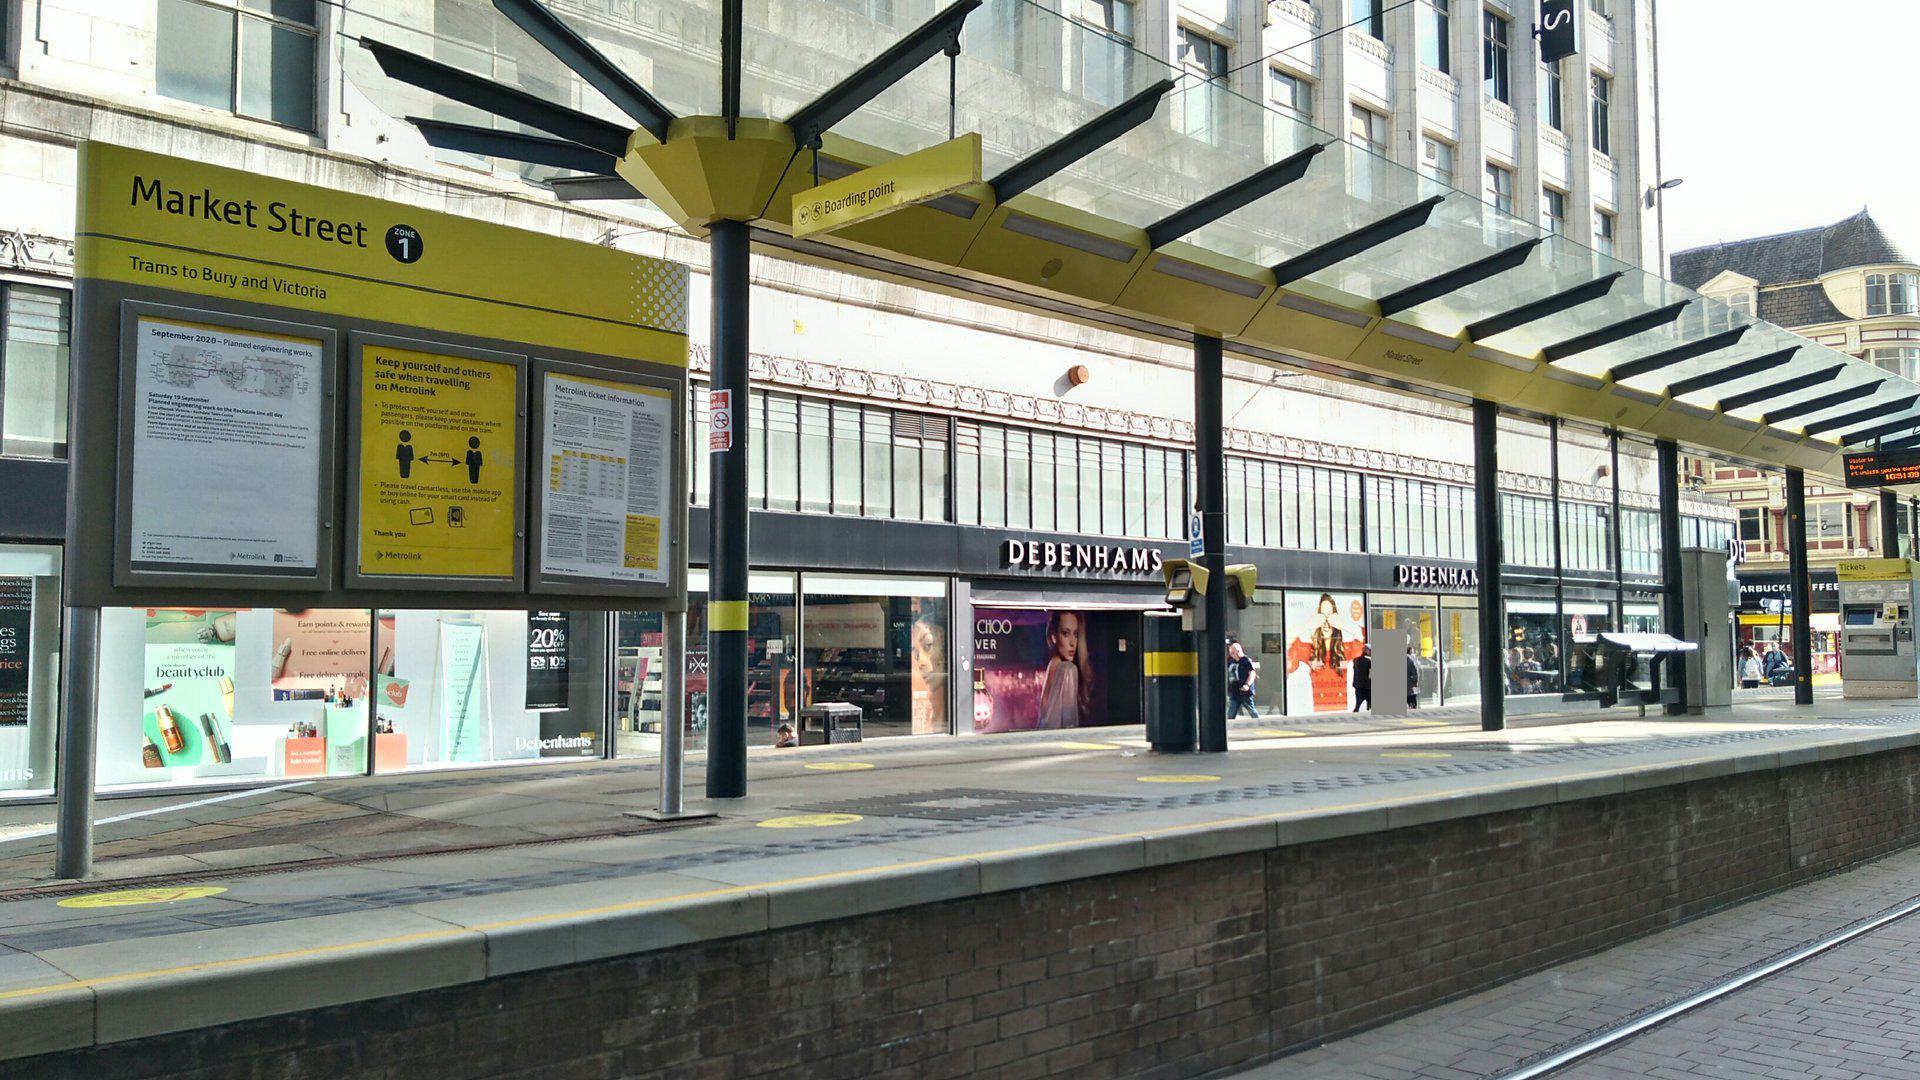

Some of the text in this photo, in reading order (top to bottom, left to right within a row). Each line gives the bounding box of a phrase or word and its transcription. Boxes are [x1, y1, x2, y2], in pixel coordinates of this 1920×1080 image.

[824, 180, 896, 215] Boarding point
[131, 176, 368, 248] Market Street
[394, 228, 416, 238] ZONE
[398, 238, 409, 260] 1
[129, 256, 327, 300] Trams to Bury and Victoria
[152, 328, 194, 343] September
[196, 336, 217, 344] 2020
[223, 338, 252, 350] Planned
[252, 342, 293, 356] engineering
[293, 348, 313, 358] works
[376, 356, 491, 380] Keep yourself and others
[376, 370, 470, 391] safe when travelling
[148, 392, 173, 400] Saturday
[375, 383, 436, 397] on Metrolink
[554, 384, 588, 398] Metrolink
[588, 390, 606, 401] ticket
[608, 392, 645, 408] information
[389, 404, 410, 412] protect
[416, 413, 434, 421] please
[424, 422, 449, 430] platform
[380, 482, 400, 490] Please
[472, 488, 491, 496] mobile
[387, 490, 399, 498] buy
[373, 530, 406, 540] Thank you
[236, 552, 266, 561] Metrolink
[386, 551, 422, 561] Metrolink
[1006, 539, 1163, 572] DEBENHAMS
[315, 620, 337, 630] points
[976, 619, 1012, 634] CHOO
[530, 628, 566, 648] 20%
[341, 649, 367, 658] delivery
[156, 666, 225, 680] beautyclub
[515, 734, 592, 752] Debenhams
